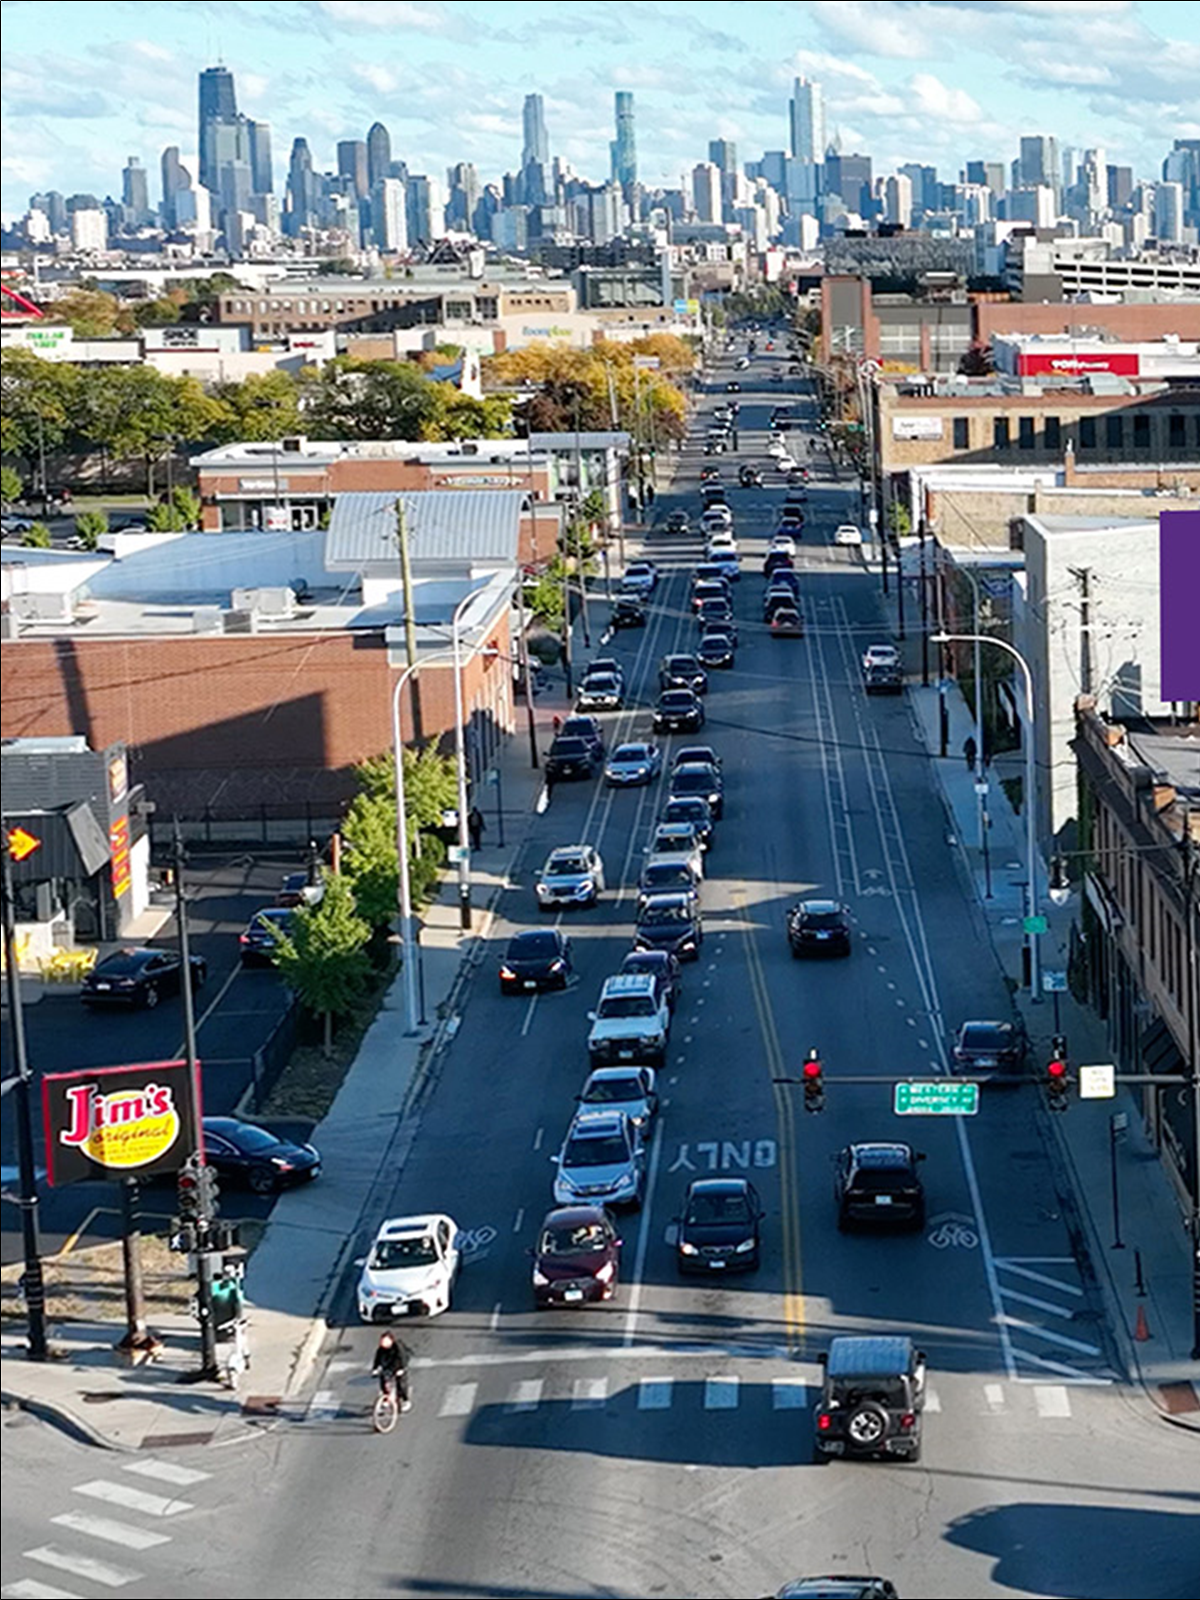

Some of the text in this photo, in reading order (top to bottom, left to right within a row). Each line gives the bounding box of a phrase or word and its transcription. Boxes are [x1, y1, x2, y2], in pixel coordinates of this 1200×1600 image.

[61, 1085, 173, 1144] Jim's
[93, 1119, 171, 1145] original
[668, 1141, 777, 1172] ONLY
